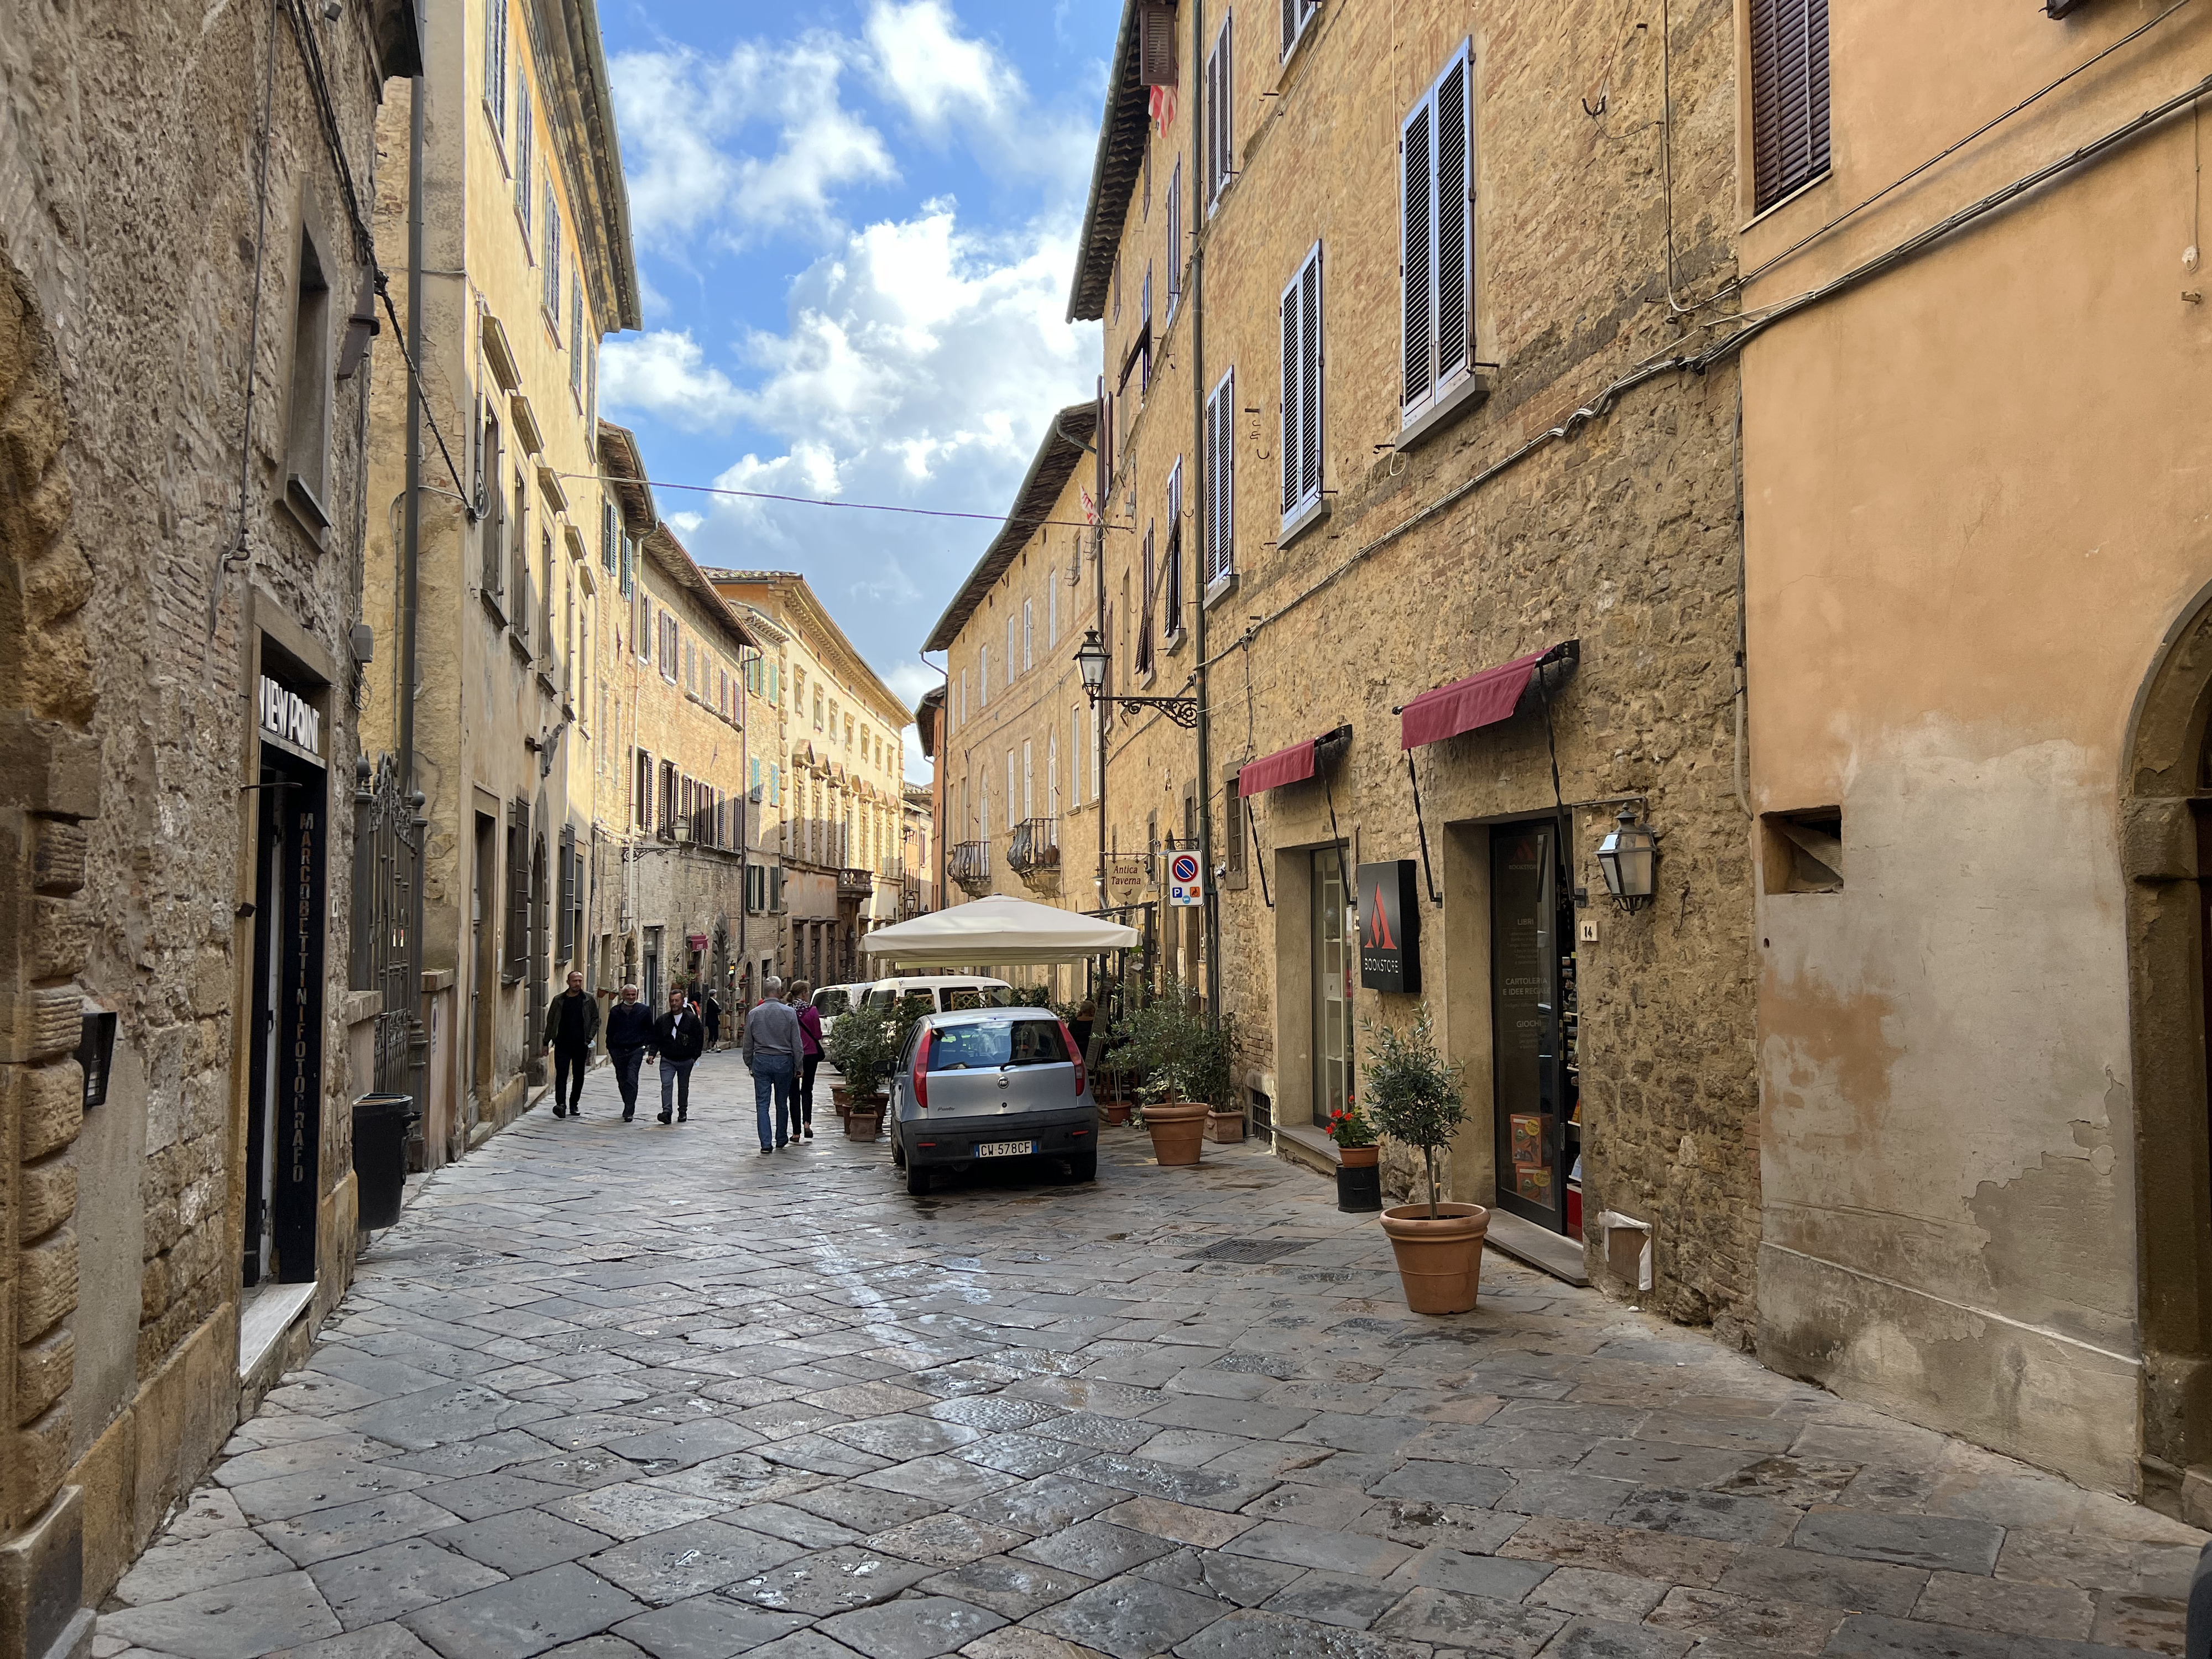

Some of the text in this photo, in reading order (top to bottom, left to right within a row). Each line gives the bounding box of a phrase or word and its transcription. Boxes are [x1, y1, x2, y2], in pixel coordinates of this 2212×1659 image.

[1113, 865, 1138, 874] Antica
[1111, 876, 1141, 885] Taverna
[1174, 888, 1181, 897] P
[1364, 958, 1399, 973] BOOKSTORE
[981, 1144, 994, 1156] CW
[998, 1141, 1030, 1155] 578CF
